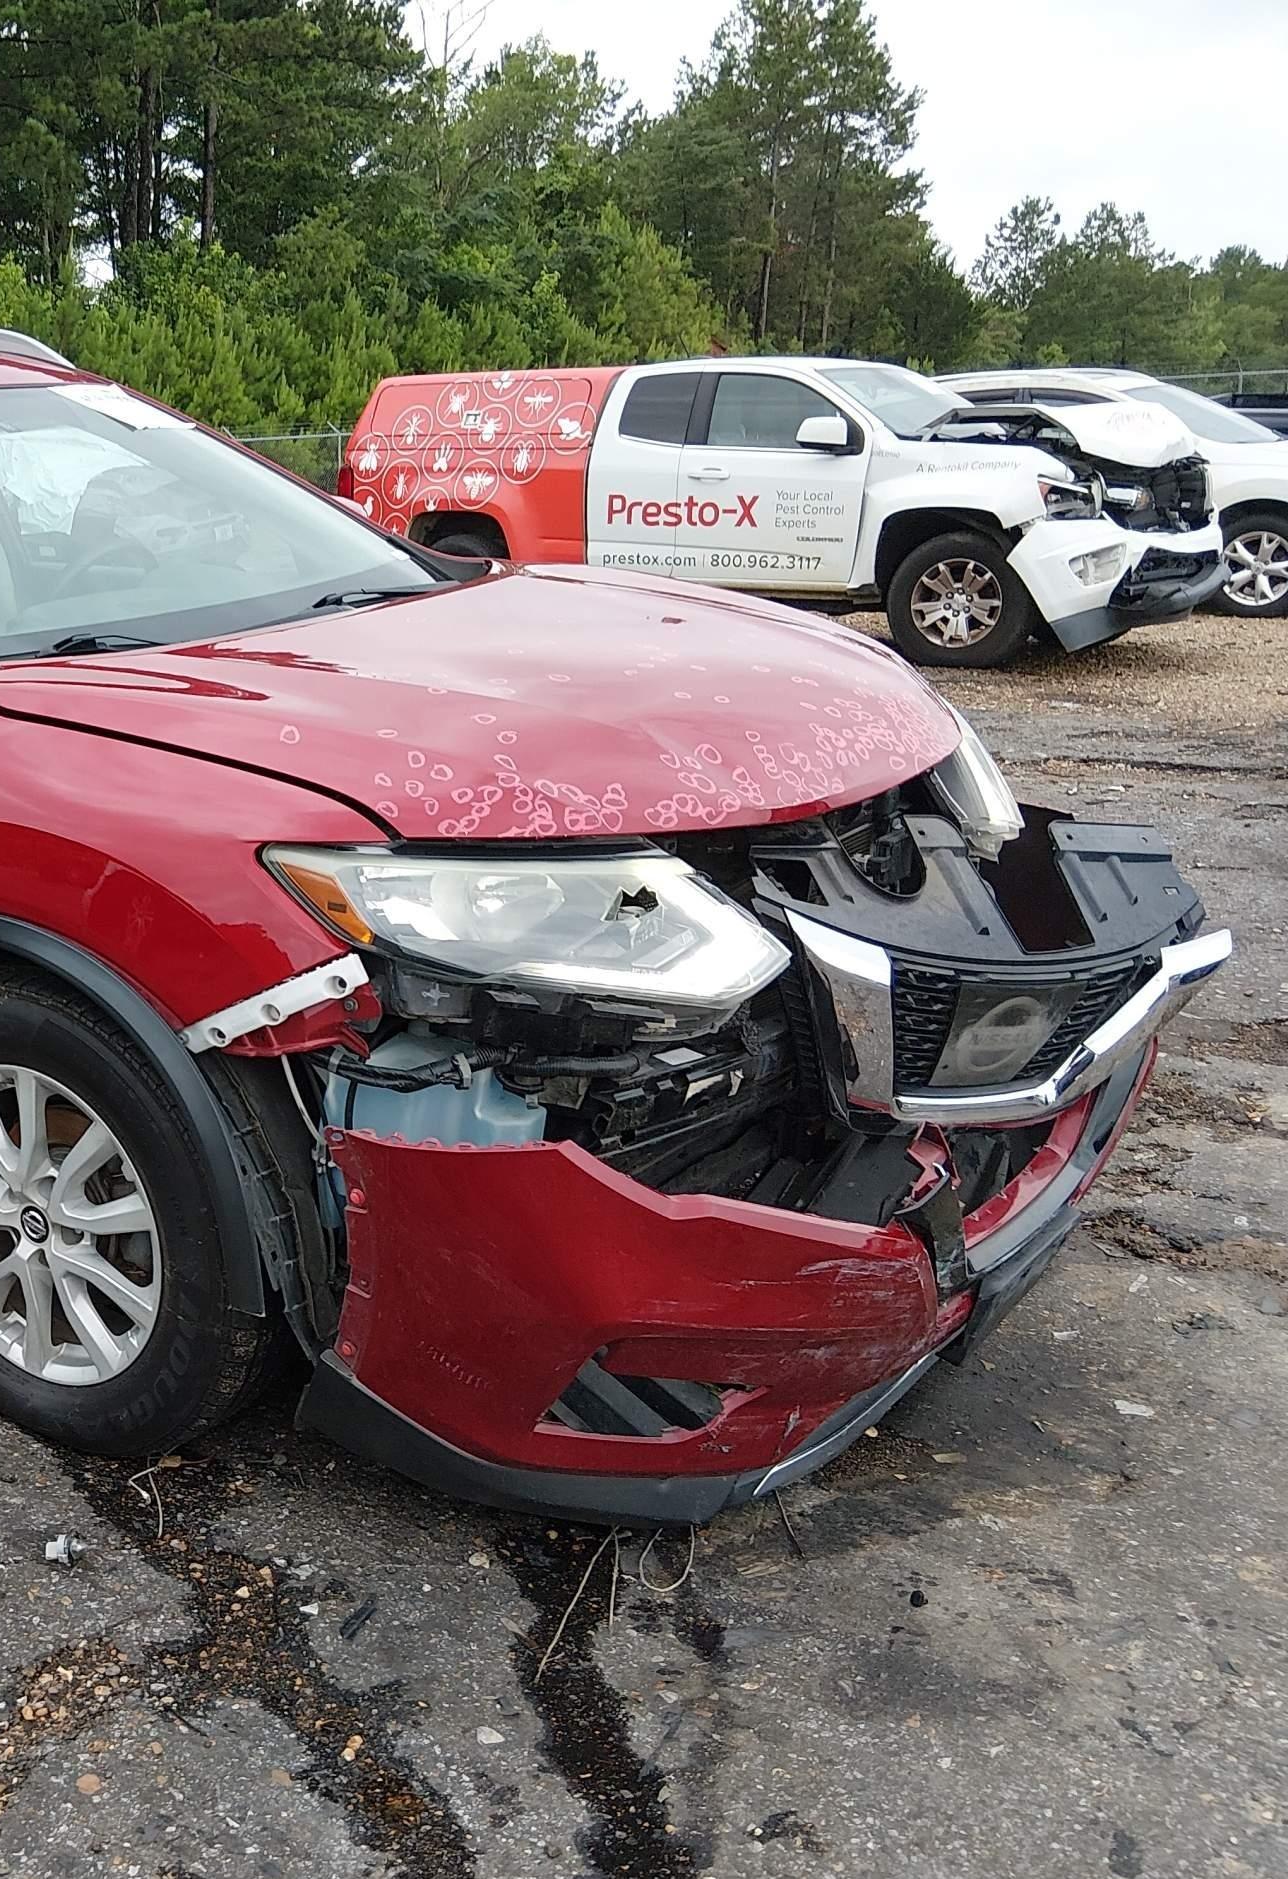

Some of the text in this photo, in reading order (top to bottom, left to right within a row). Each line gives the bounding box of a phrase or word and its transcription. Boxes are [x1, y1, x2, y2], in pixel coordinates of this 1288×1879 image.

[915, 459, 1020, 473] A Rentokil Company
[776, 489, 834, 502] Your Local
[606, 494, 761, 528] Presto-X
[775, 503, 845, 516] Pest Control
[774, 516, 817, 531] Experts
[602, 552, 822, 570] prestox.com 800.962.3117
